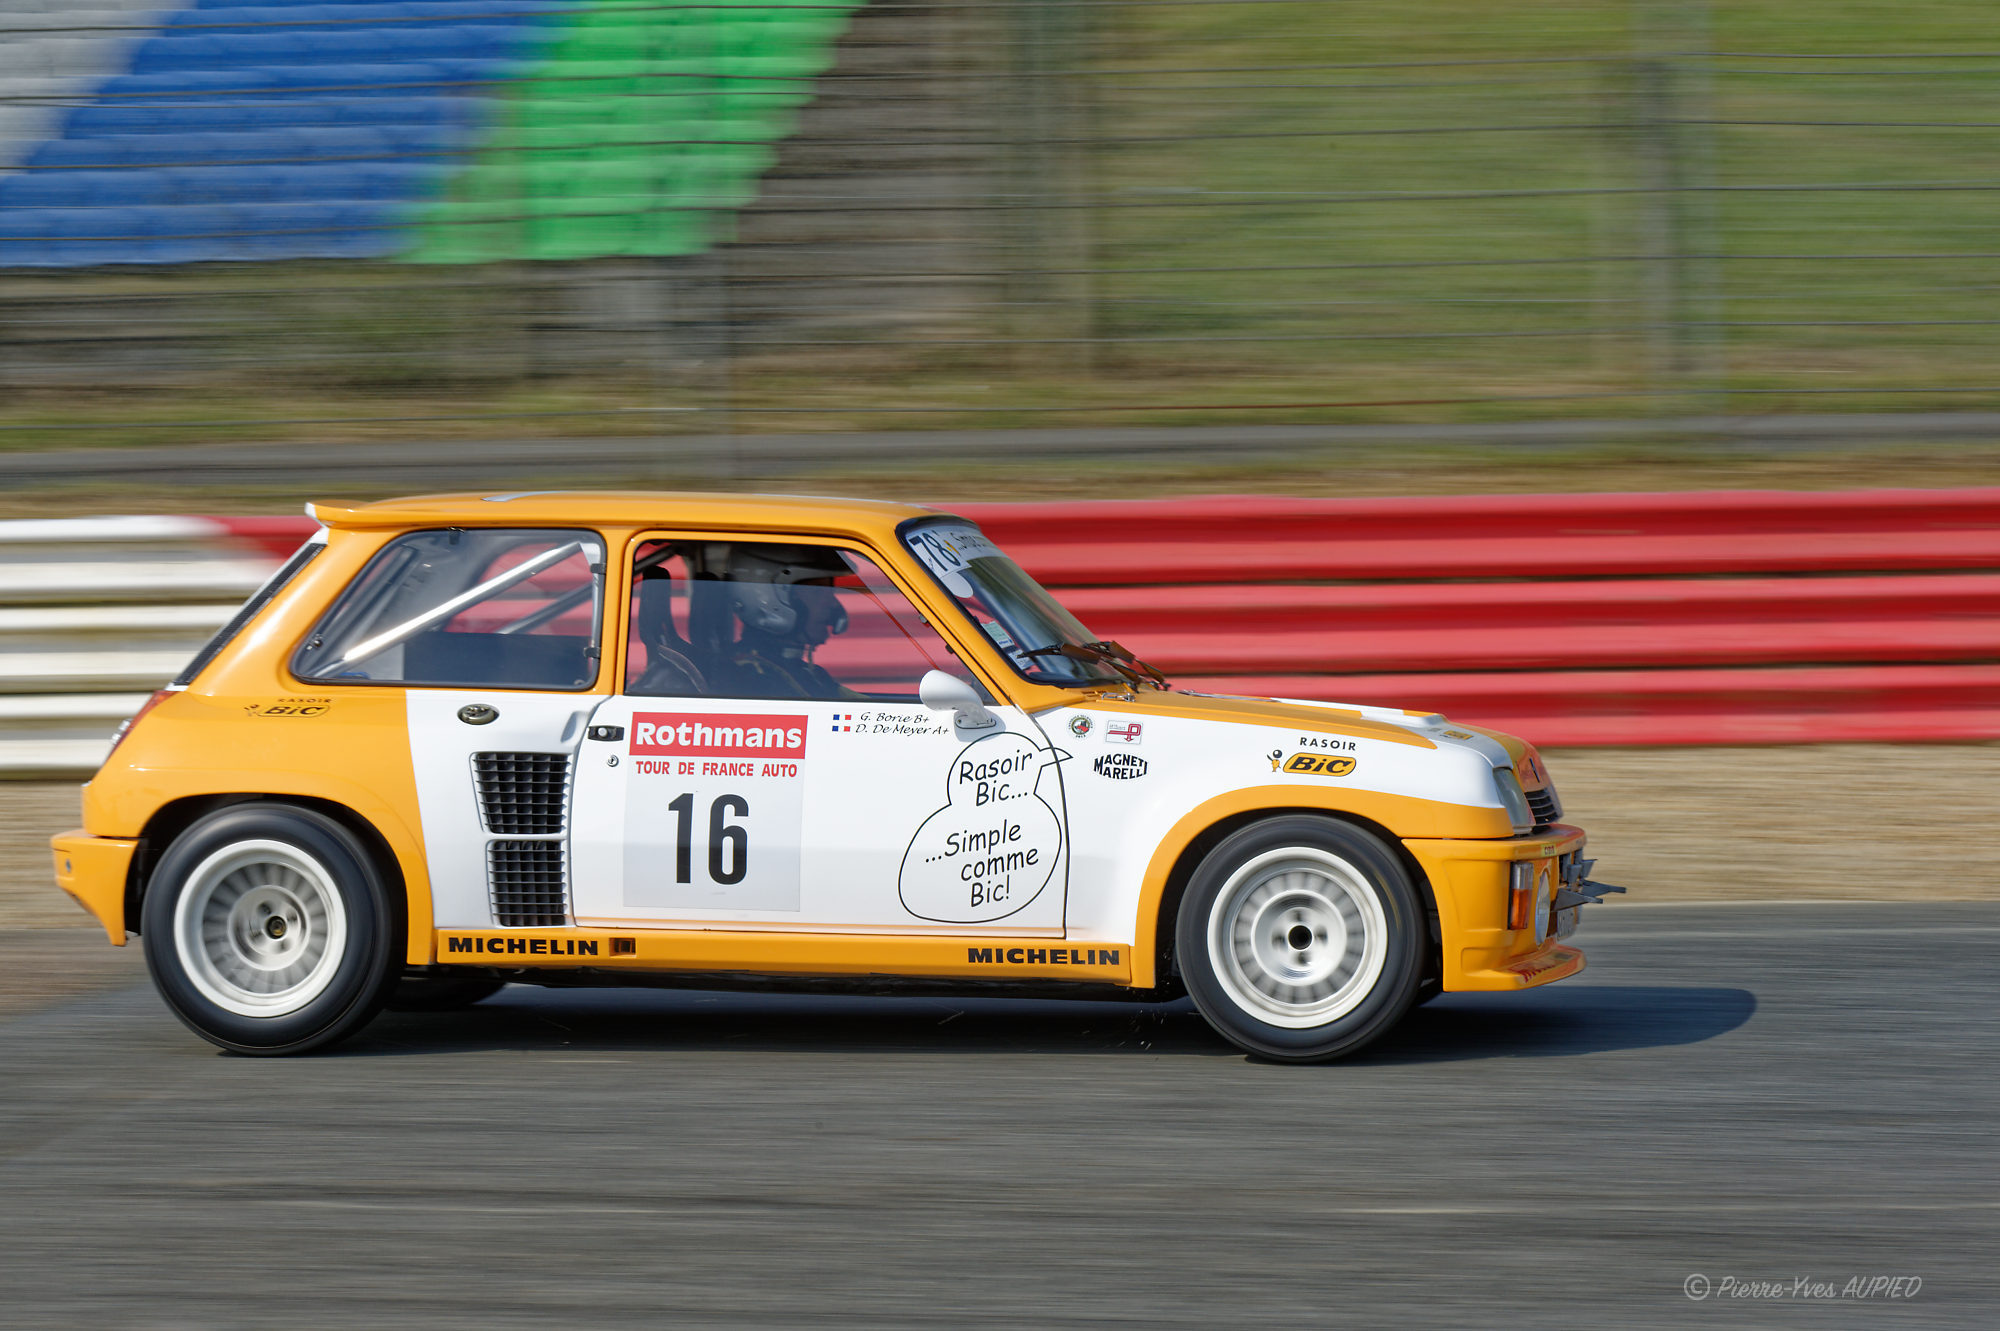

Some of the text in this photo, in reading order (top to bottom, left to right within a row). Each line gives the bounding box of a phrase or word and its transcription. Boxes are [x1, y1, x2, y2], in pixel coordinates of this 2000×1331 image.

[908, 532, 961, 572] 78
[860, 711, 871, 721] G.
[914, 714, 930, 724] B+
[636, 722, 802, 749] Rothmans
[855, 723, 868, 733] D.
[892, 723, 932, 737] Meyer
[932, 725, 950, 735] A+
[1299, 736, 1356, 752] RASOIR
[636, 760, 798, 778] TOUR DE FRANCE AUTO
[959, 749, 1033, 785] Rasoir
[1093, 753, 1148, 773] MAGNETI
[668, 793, 749, 885] 16
[960, 848, 1039, 882] comme
[970, 874, 1011, 908] Bic!
[448, 937, 599, 956] MICHELIN
[967, 948, 1120, 966] MICHELIN
